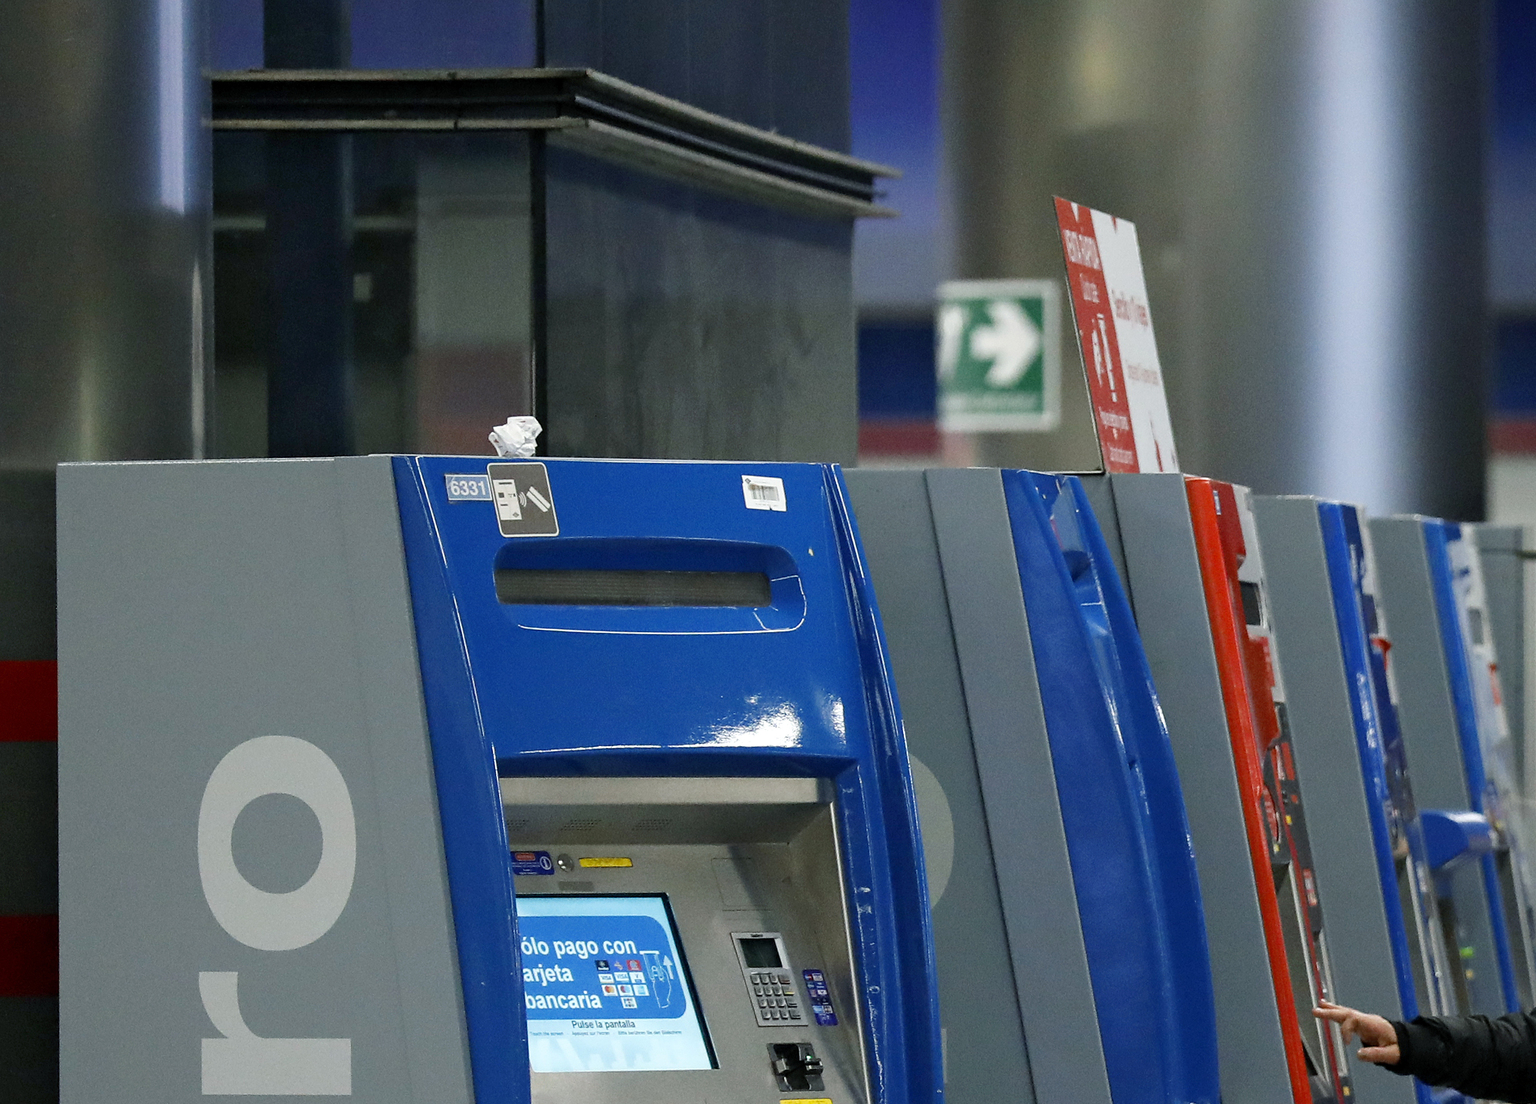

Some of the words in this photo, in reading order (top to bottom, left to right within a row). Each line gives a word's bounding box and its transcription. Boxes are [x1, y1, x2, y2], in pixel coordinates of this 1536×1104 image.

[450, 481, 486, 496] 6331
[521, 937, 549, 955] ólo
[553, 940, 599, 959] pago
[603, 940, 637, 955] con
[523, 964, 574, 986] arjeta
[525, 991, 602, 1009] bancaria
[571, 1020, 594, 1029] Pulse
[595, 1020, 603, 1028] la
[605, 1020, 636, 1031] pantalla
